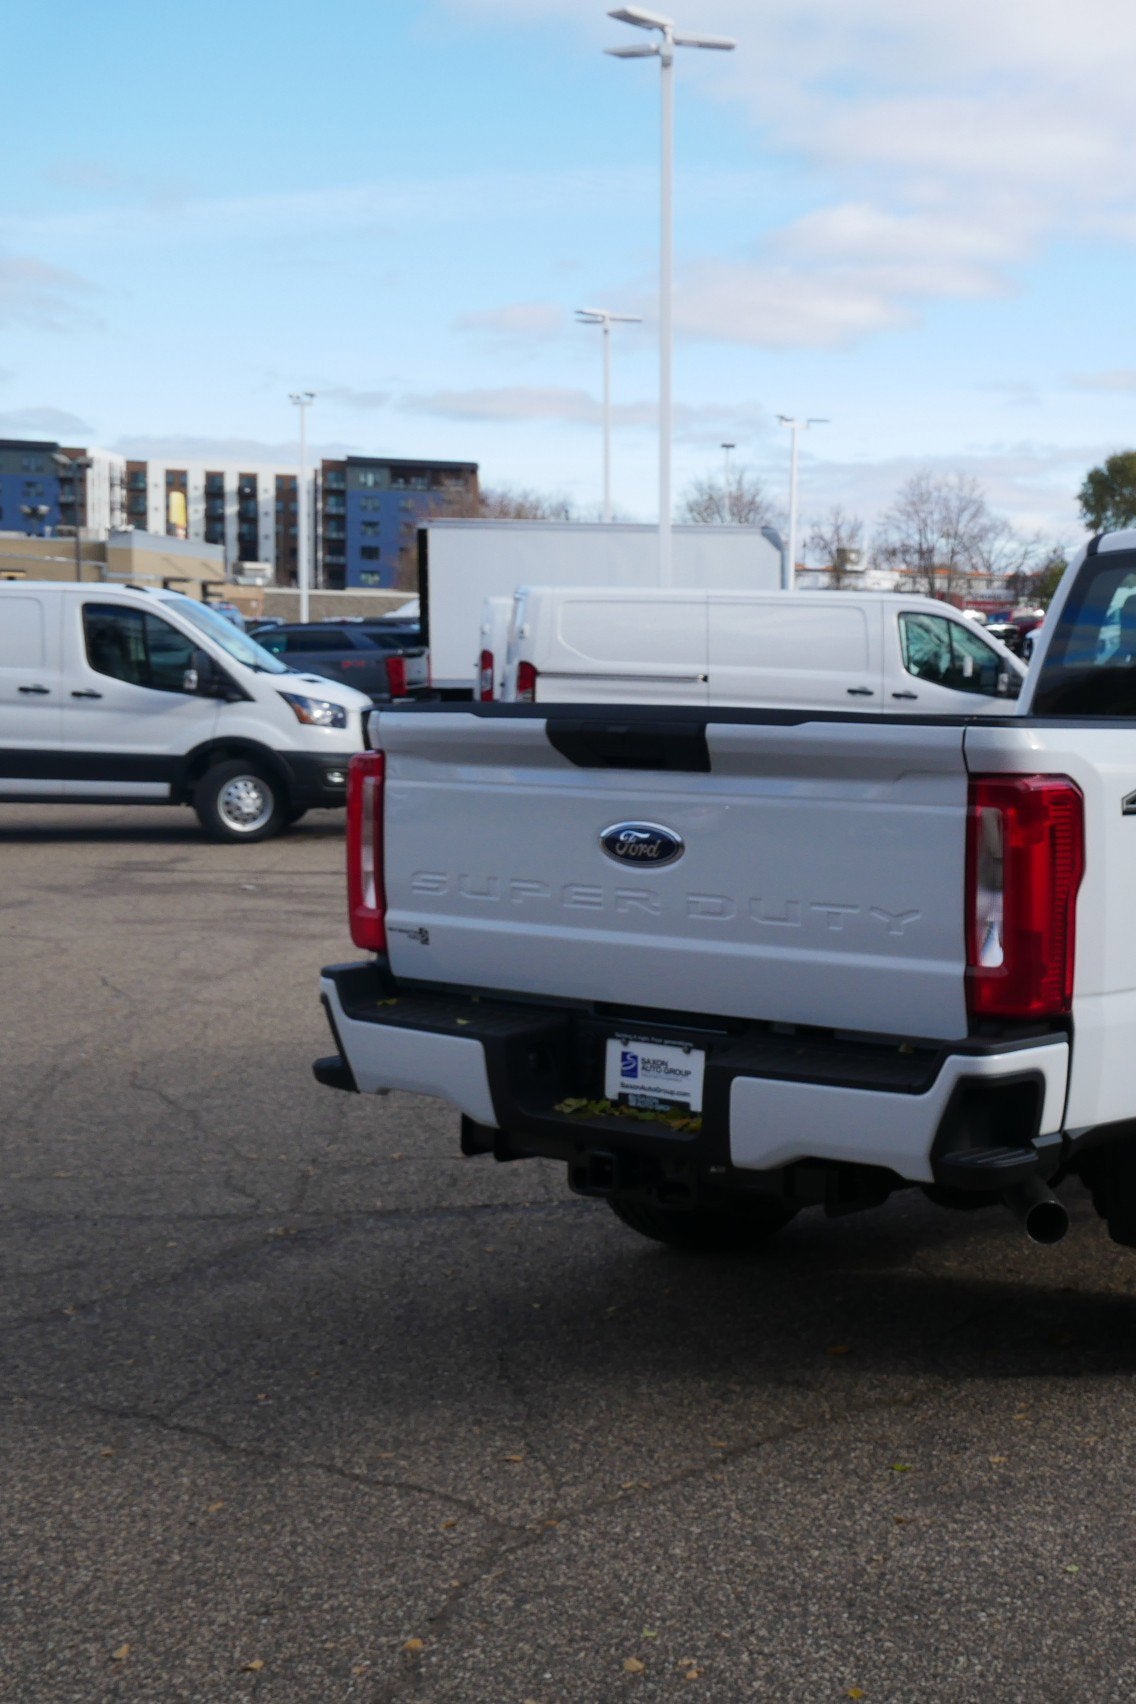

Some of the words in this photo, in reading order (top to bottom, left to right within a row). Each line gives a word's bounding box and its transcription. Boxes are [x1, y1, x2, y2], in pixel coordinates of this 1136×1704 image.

[614, 829, 661, 858] Ford
[411, 871, 661, 916] SUPER
[686, 892, 923, 936] DUTY
[641, 1057, 668, 1067] SAXON
[641, 1065, 662, 1073] AUTO
[663, 1067, 692, 1077] GROUP
